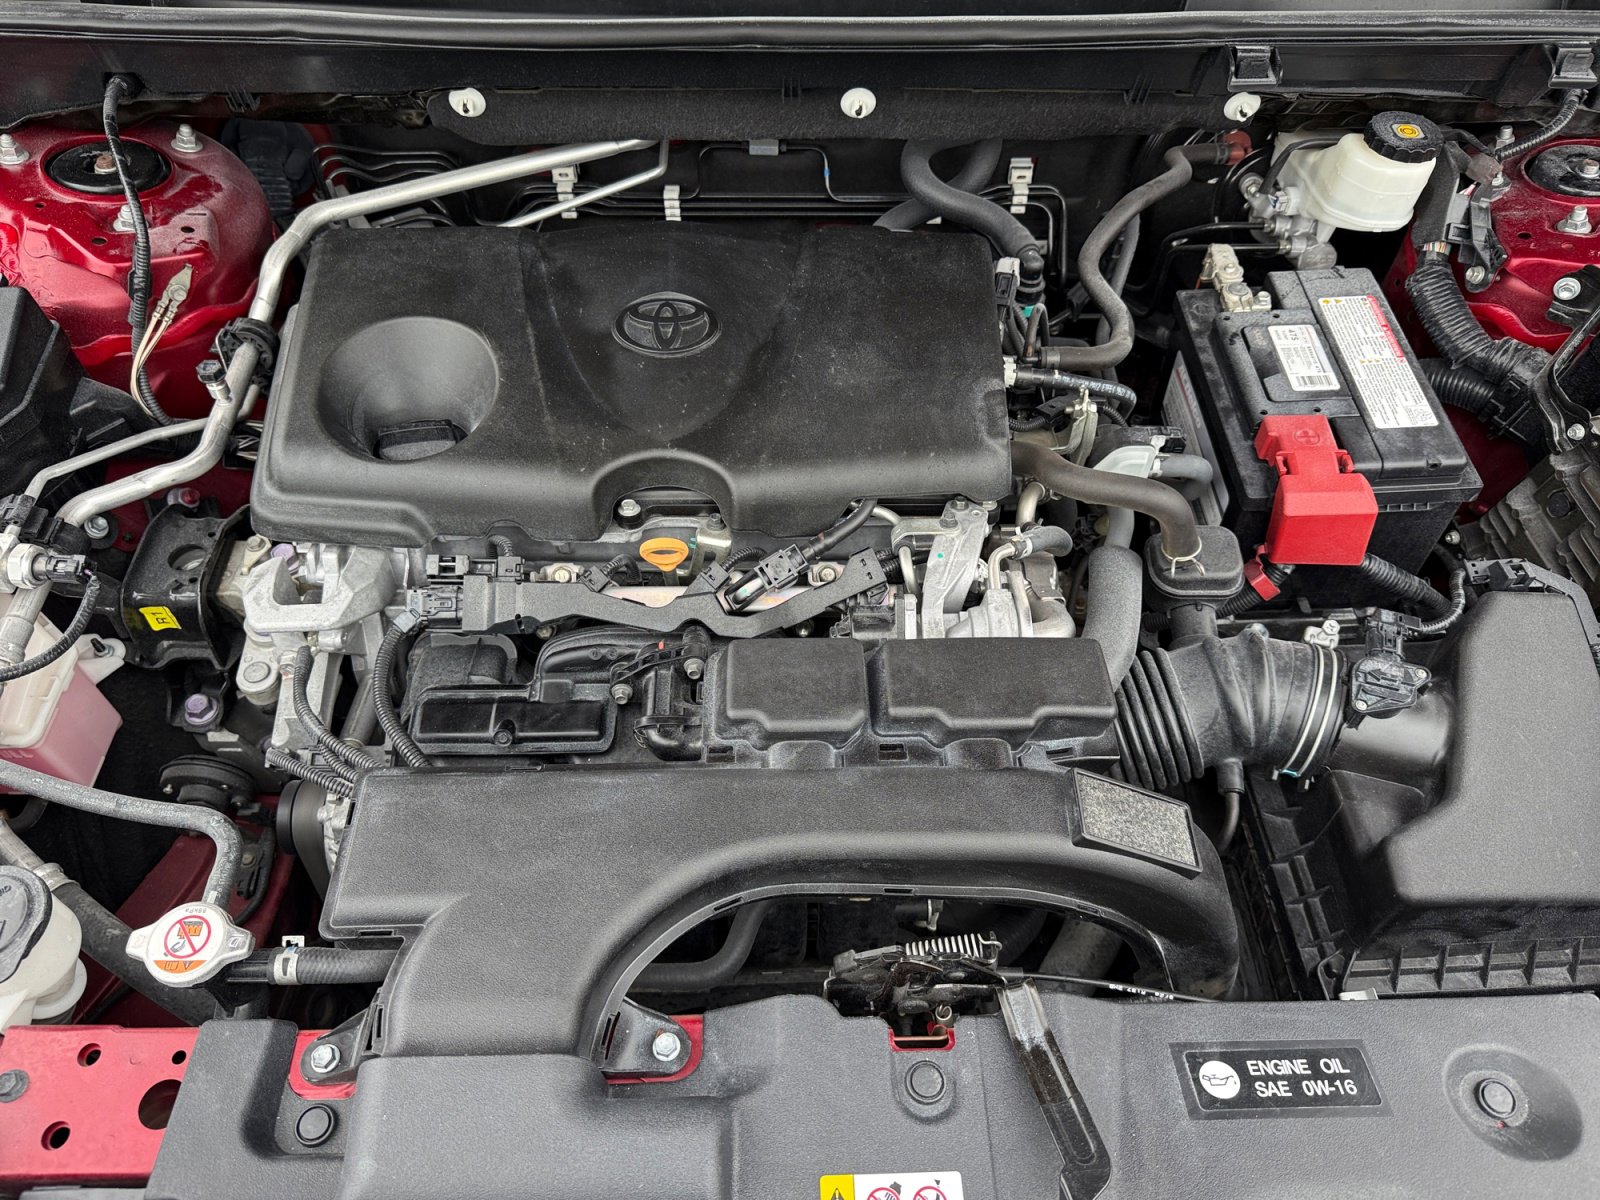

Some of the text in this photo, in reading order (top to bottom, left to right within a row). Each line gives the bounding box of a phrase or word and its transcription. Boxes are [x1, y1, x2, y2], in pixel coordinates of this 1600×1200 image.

[1246, 1058, 1351, 1076] ENGINE OIL
[1254, 1079, 1358, 1098] SAE 0W-16
